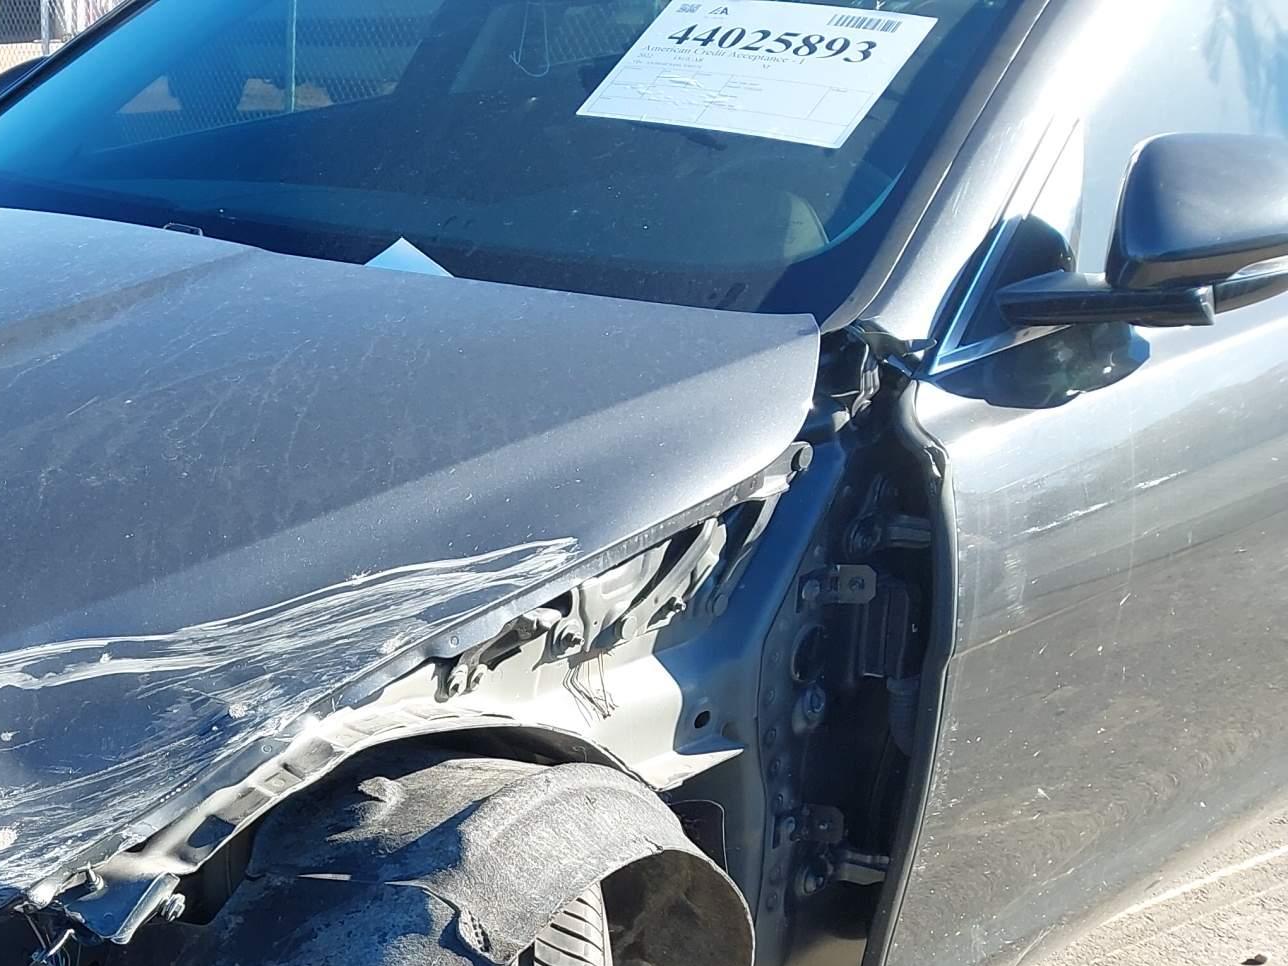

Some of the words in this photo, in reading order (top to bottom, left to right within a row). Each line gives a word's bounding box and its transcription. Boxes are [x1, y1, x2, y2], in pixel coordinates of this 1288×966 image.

[643, 44, 691, 55] American
[693, 47, 729, 57] Credit
[727, 52, 790, 64] Acceptance
[668, 24, 878, 63] 44025893
